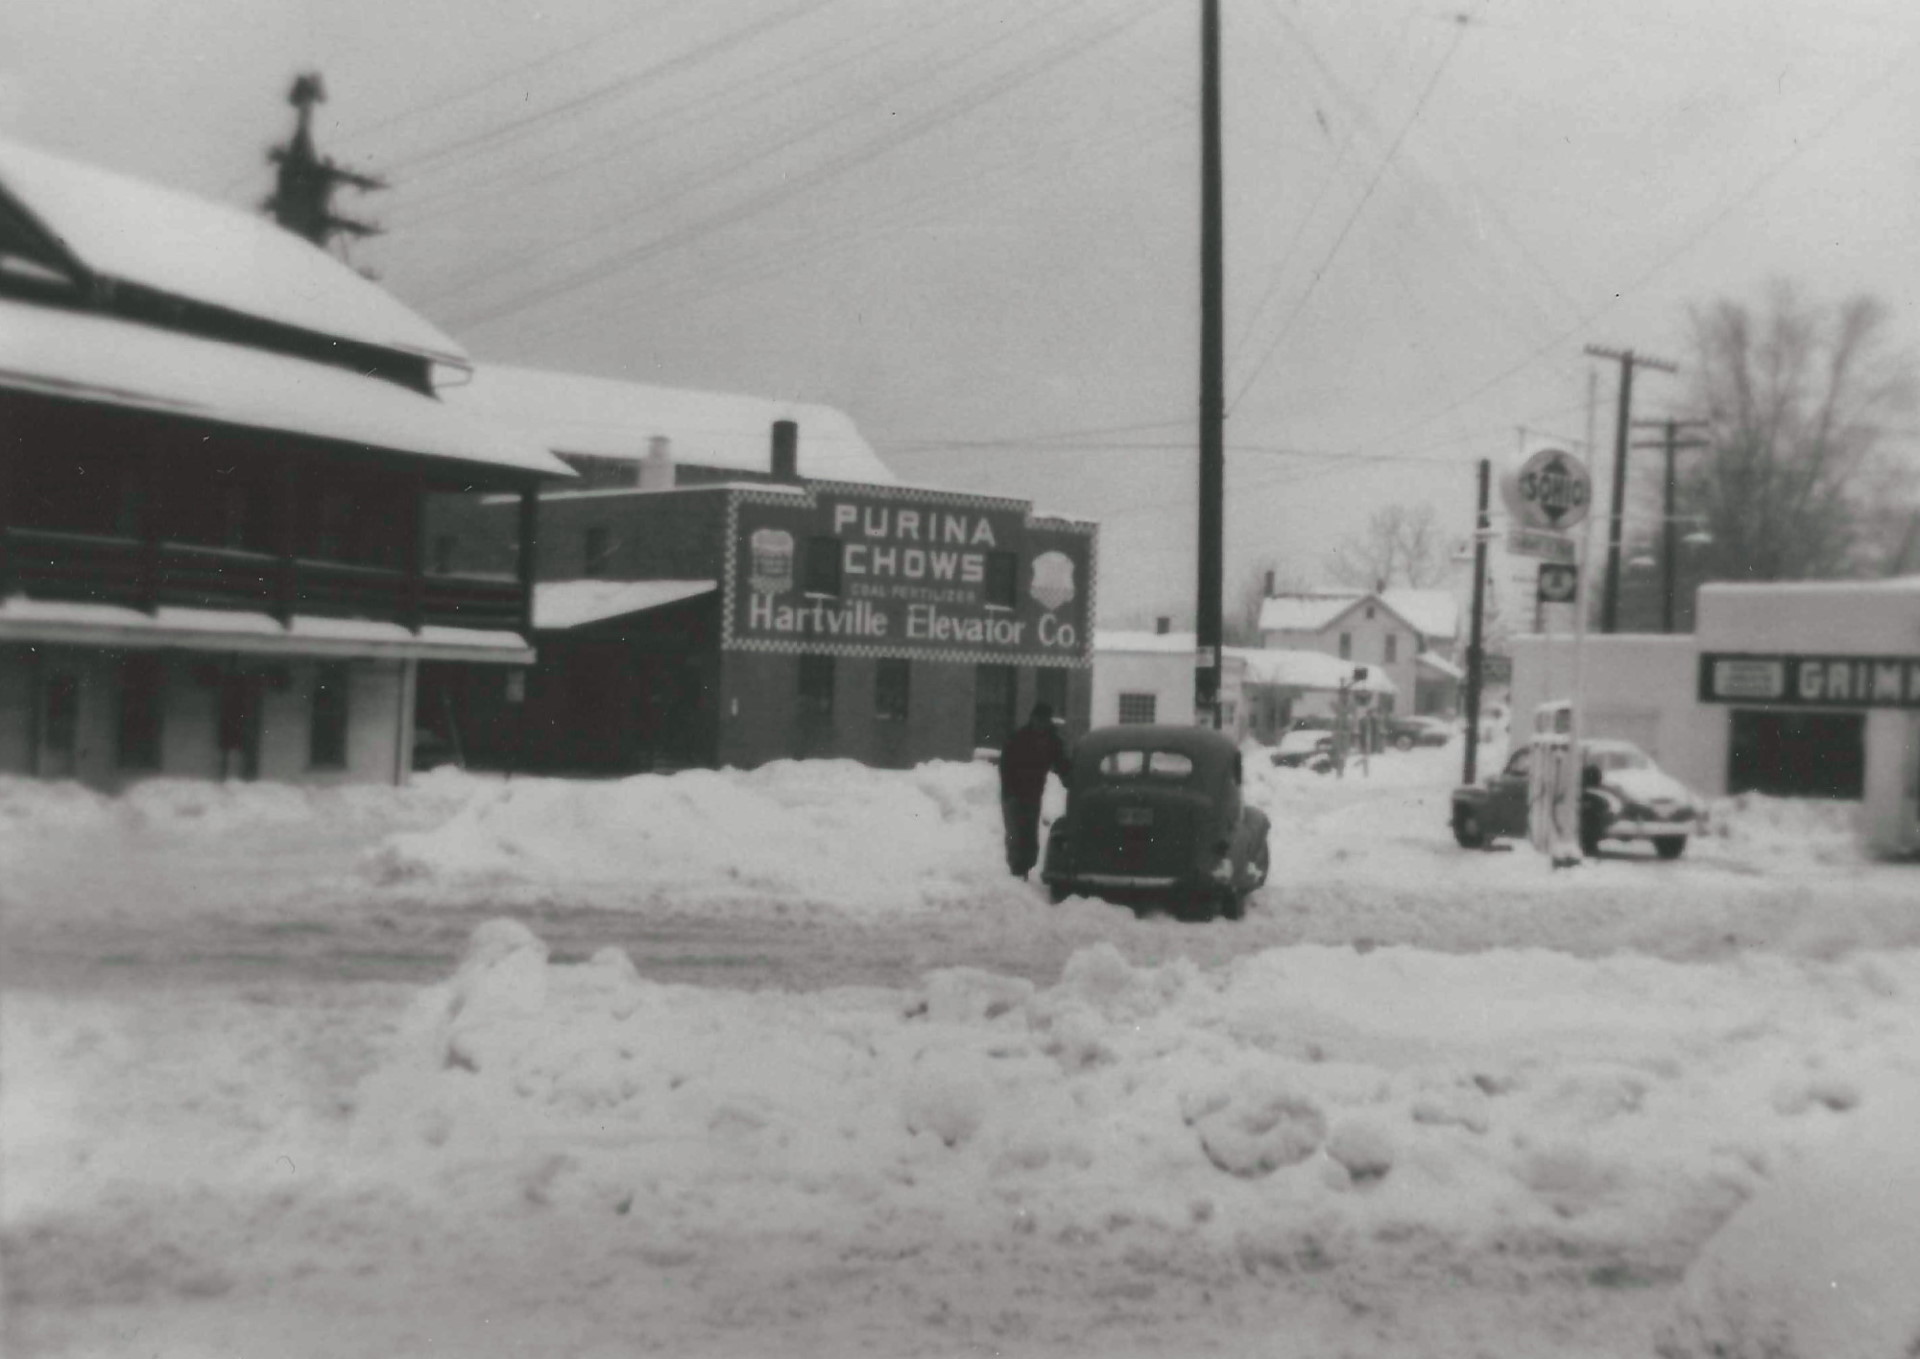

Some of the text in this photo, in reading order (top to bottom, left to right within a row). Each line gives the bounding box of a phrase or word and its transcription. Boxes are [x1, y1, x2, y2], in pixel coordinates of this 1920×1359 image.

[834, 503, 997, 546] PURINA
[842, 543, 986, 582] CHOWS
[748, 593, 1081, 648] Hartville Elevator Co.
